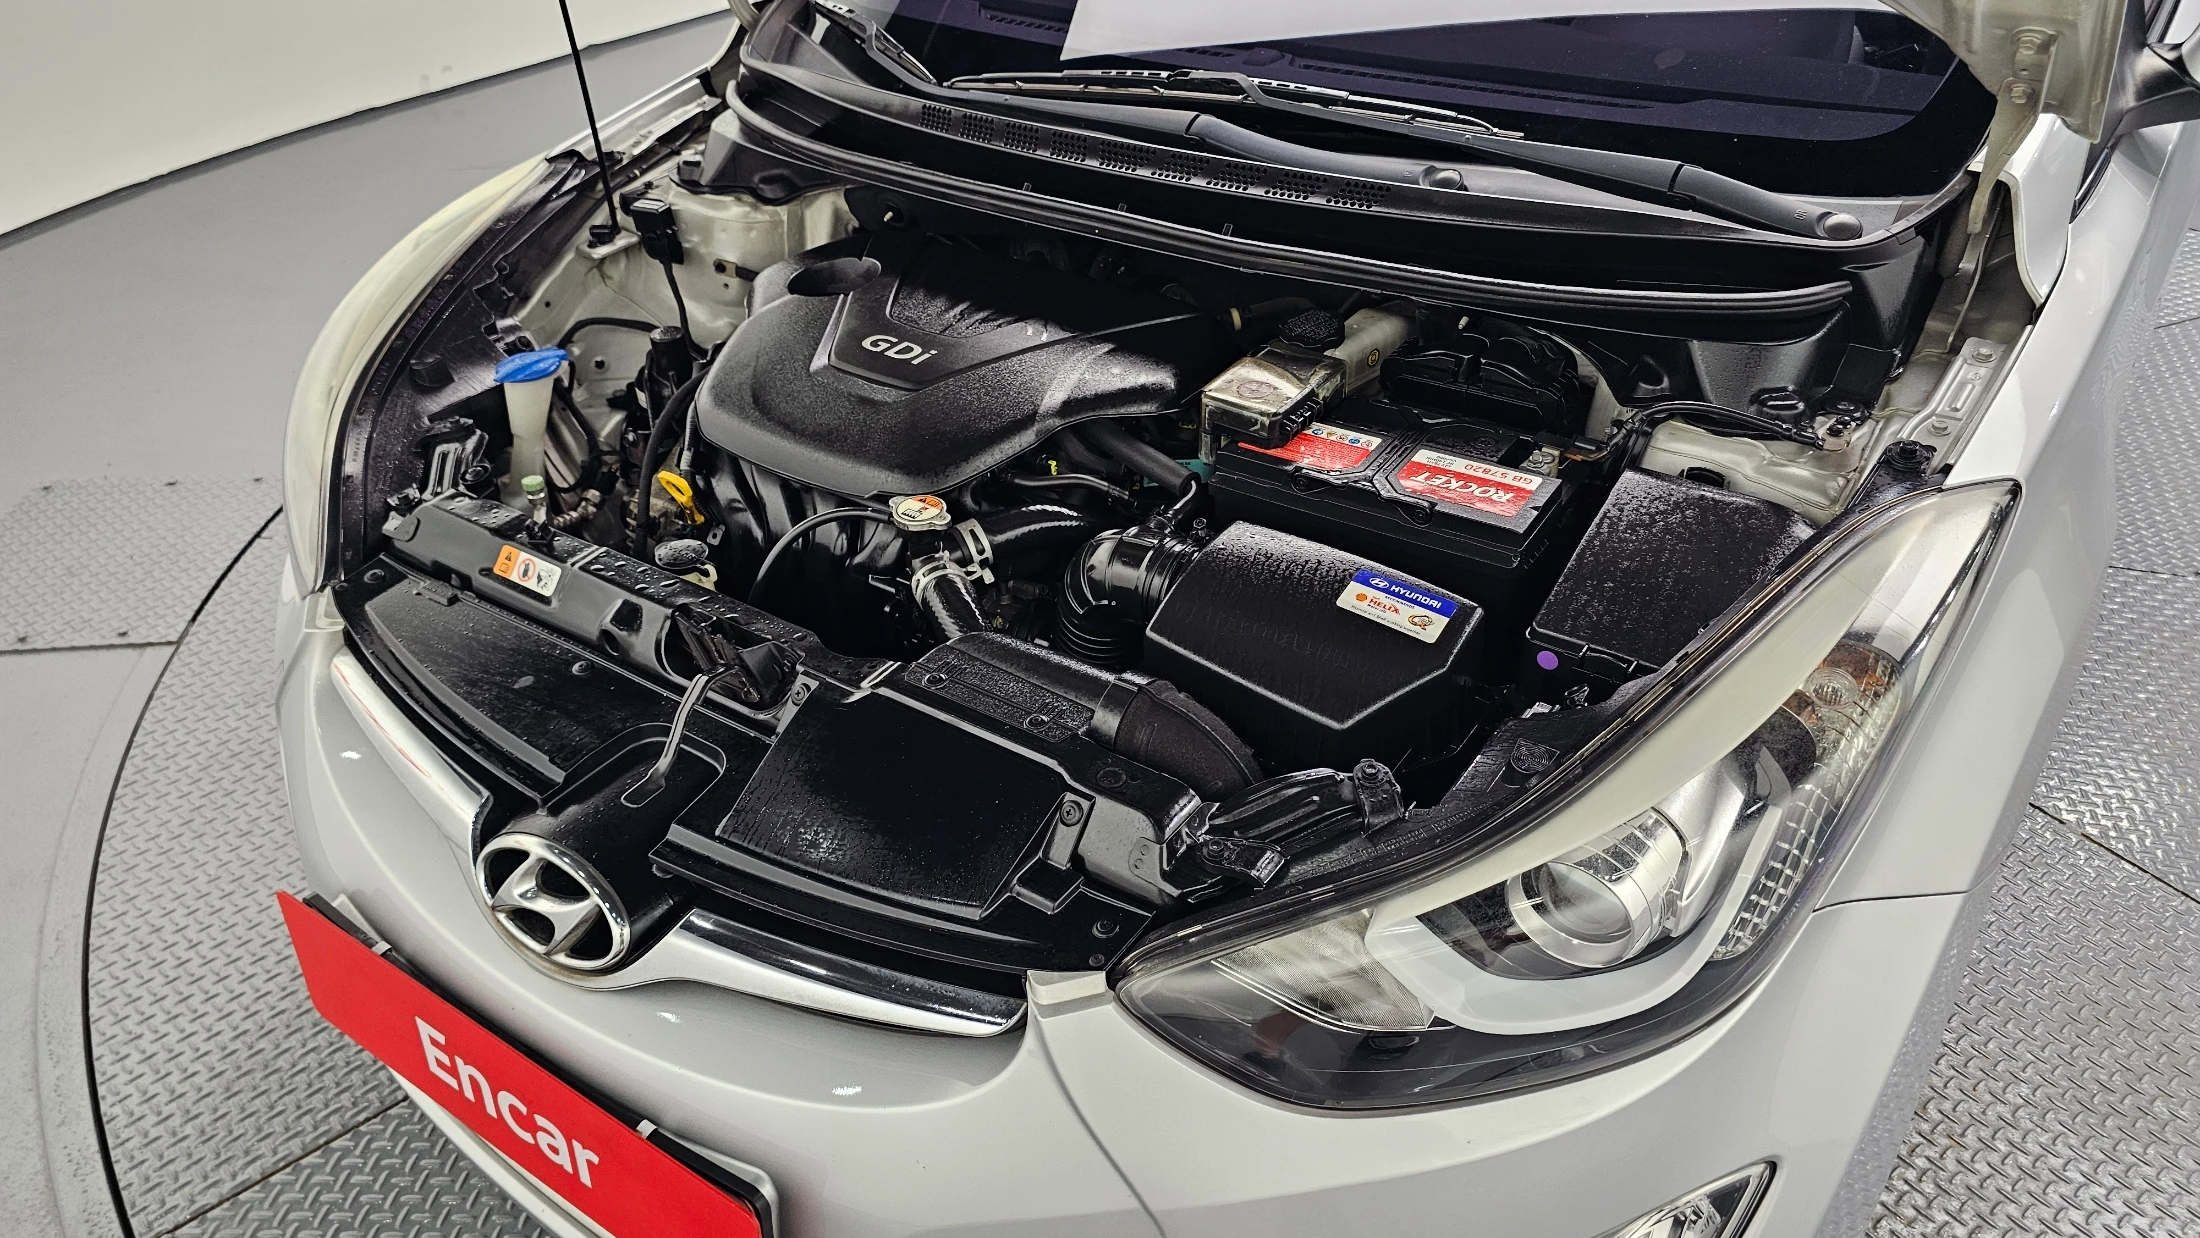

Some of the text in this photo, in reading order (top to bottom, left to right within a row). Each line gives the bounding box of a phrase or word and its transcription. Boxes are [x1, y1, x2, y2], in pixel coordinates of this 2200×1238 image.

[861, 334, 939, 365] GDi
[1410, 470, 1515, 503] ROCKET
[1464, 463, 1533, 485] GB 57820
[1368, 598, 1400, 615] HELIX
[1390, 584, 1442, 609] HYUNDAI
[415, 1016, 600, 1189] Encar
